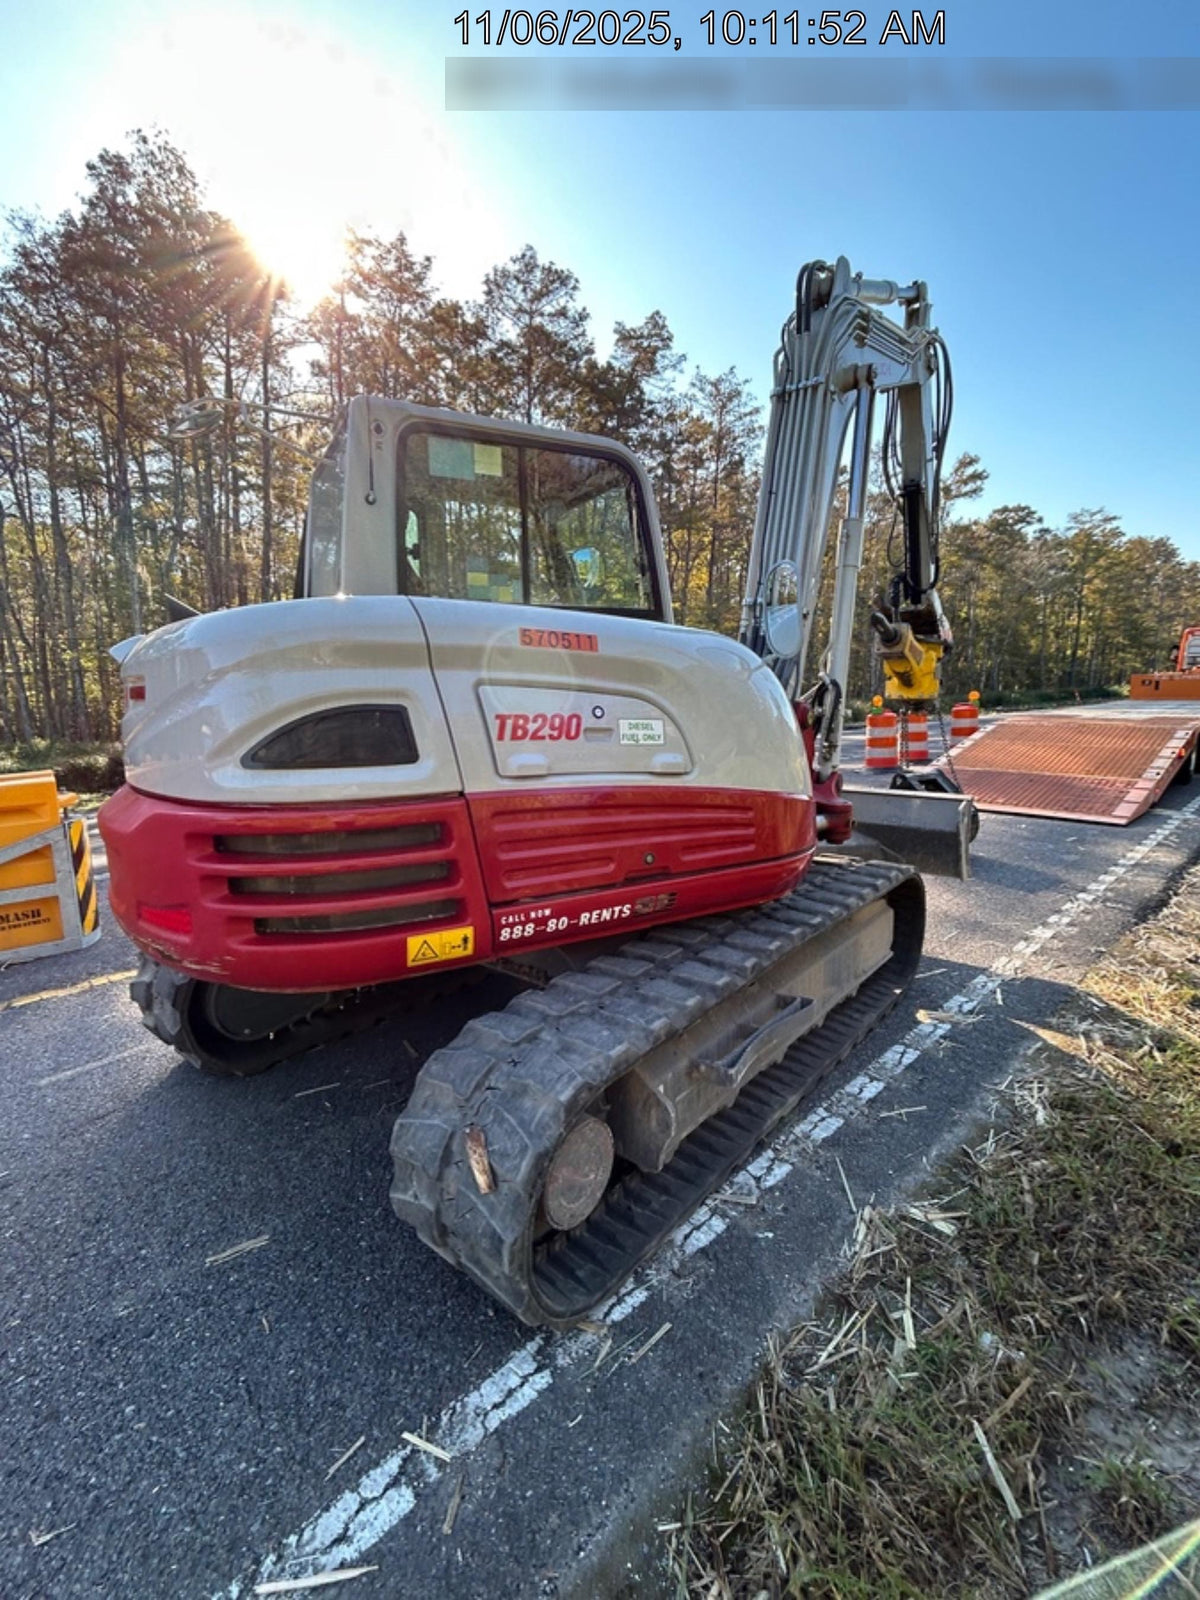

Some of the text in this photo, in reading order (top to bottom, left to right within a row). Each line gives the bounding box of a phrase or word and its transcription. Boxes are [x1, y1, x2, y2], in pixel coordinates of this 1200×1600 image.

[521, 629, 595, 650] 570511
[495, 713, 582, 741] TB290
[628, 722, 655, 731] DIESEL
[621, 733, 662, 743] FUEL ONLY
[499, 904, 632, 942] 888-80-RENTS
[501, 908, 552, 924] CALL NOW
